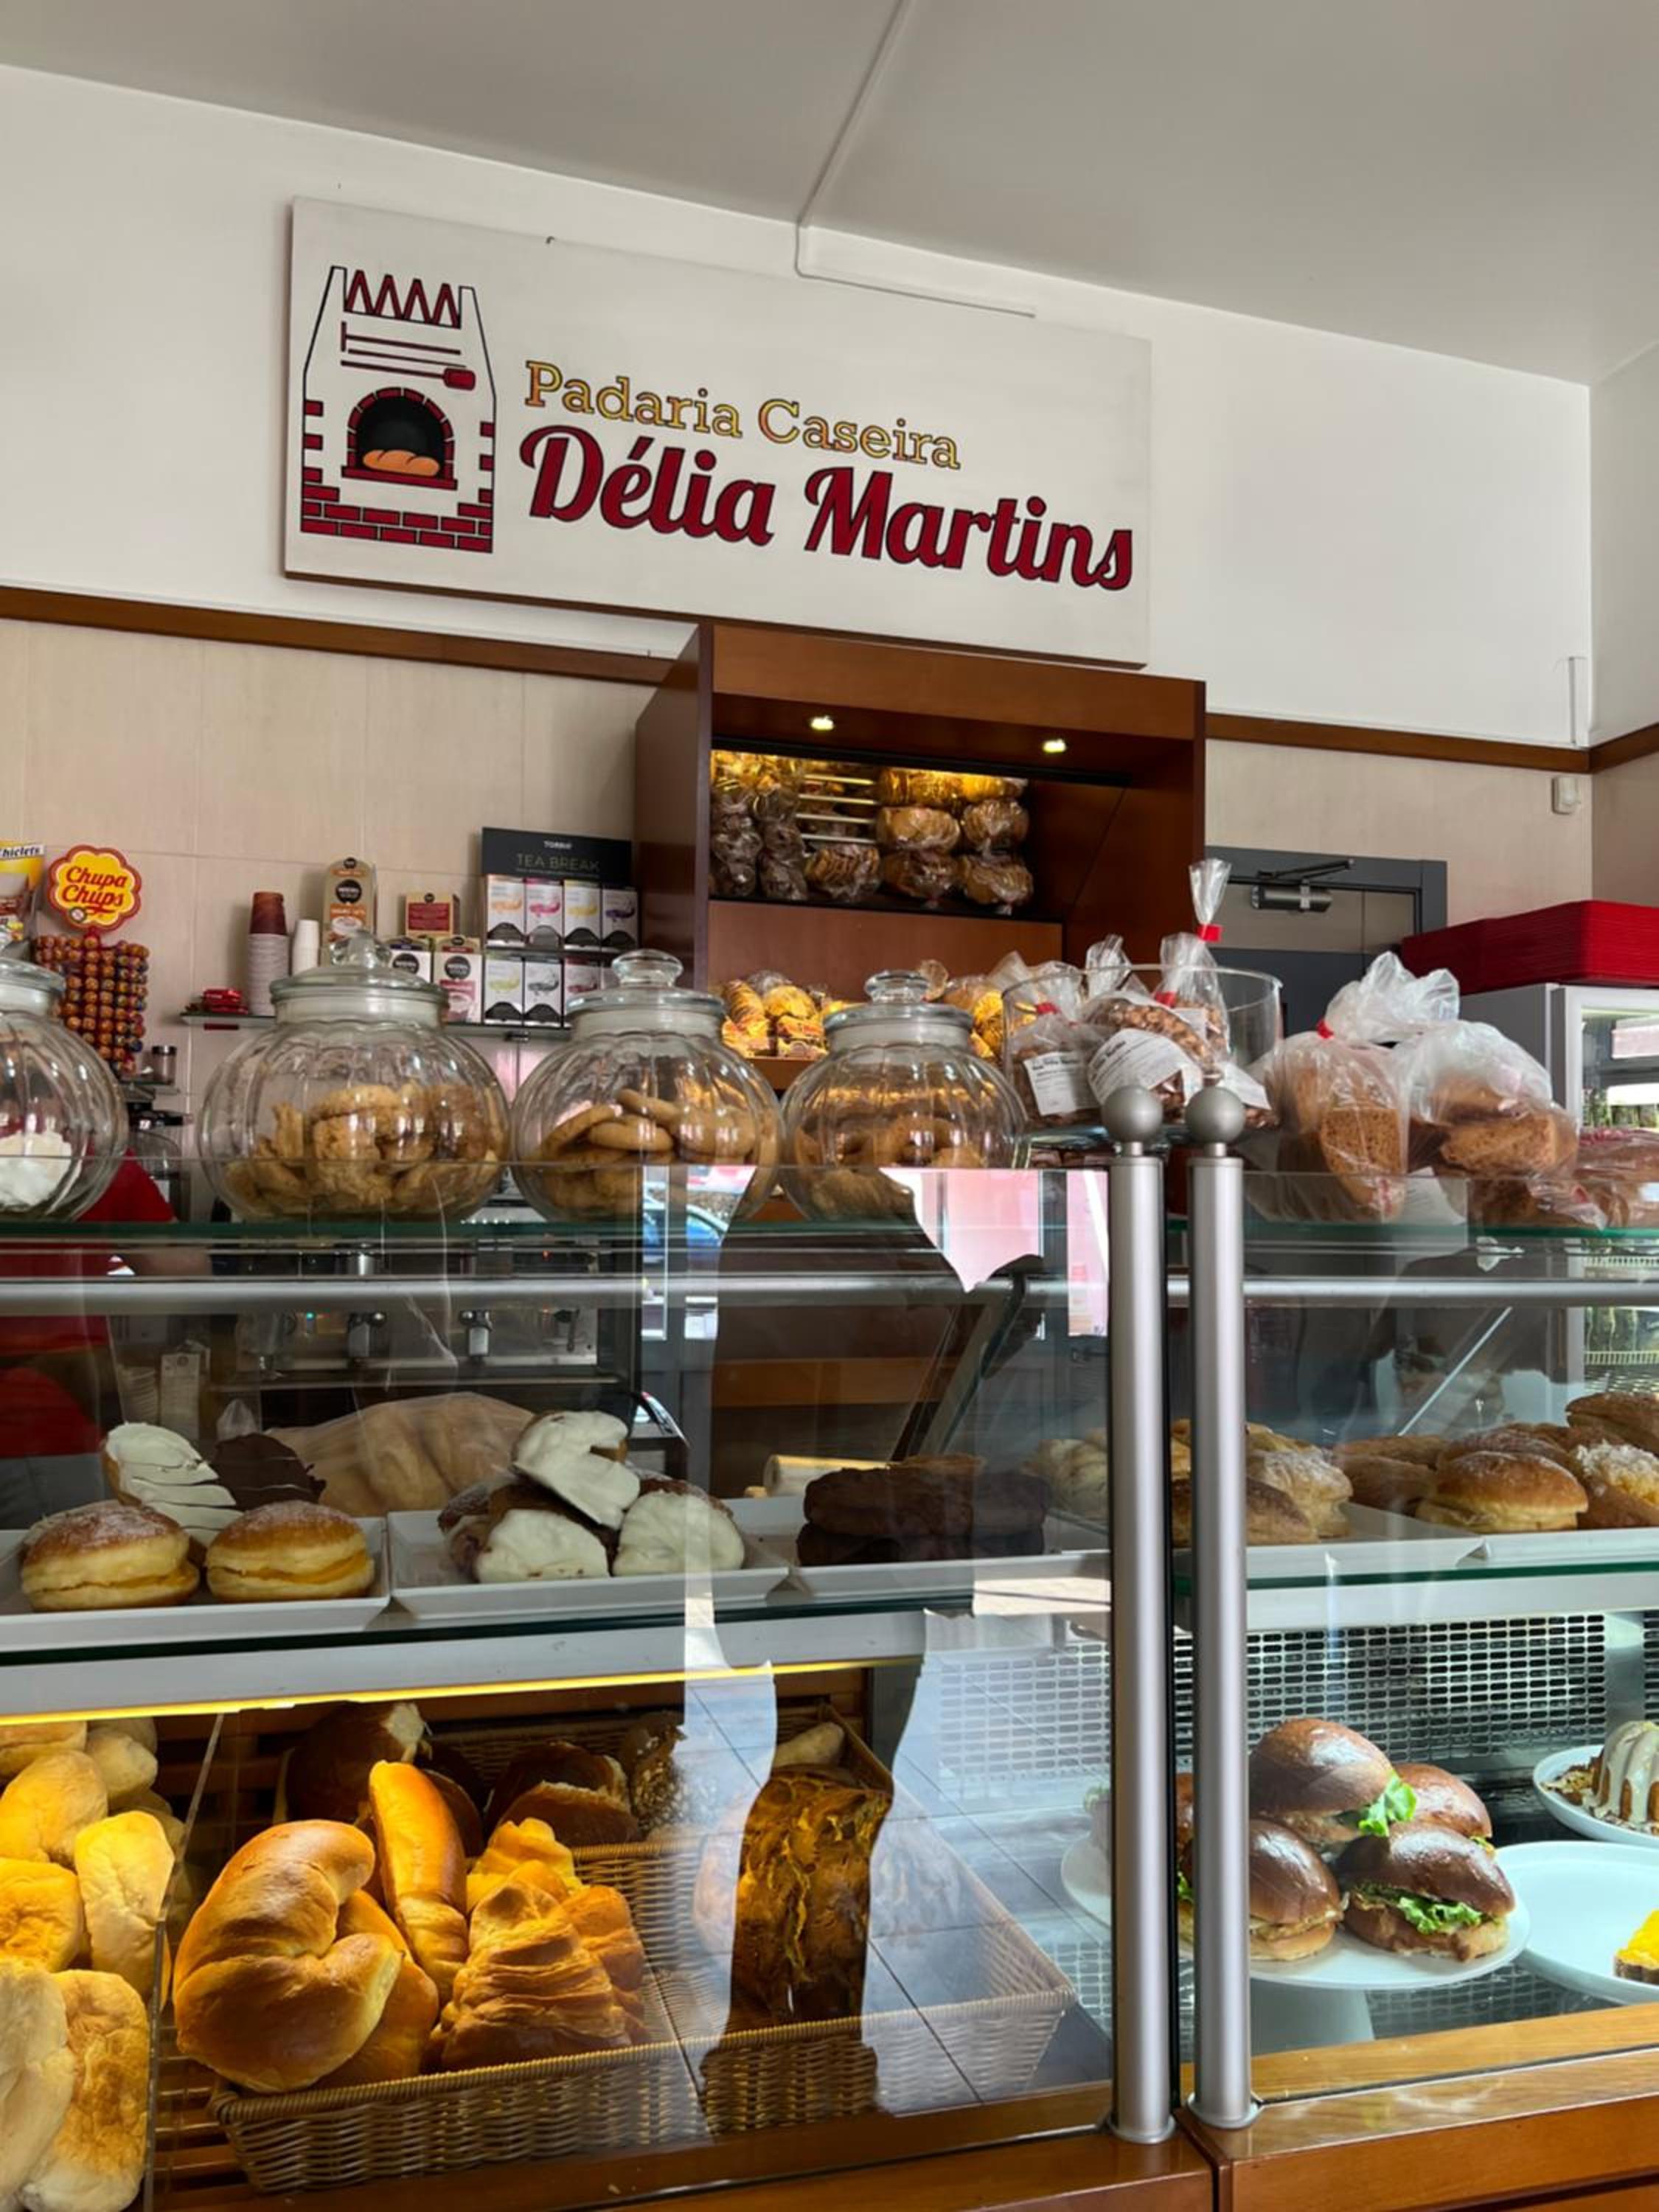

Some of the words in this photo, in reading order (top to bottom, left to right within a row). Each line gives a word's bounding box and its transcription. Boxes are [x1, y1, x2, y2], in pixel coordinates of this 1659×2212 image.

[524, 360, 743, 439] Padaria
[758, 398, 961, 470] Caseira
[519, 425, 776, 547] Délia
[804, 466, 1133, 591] Martins
[0, 846, 40, 858] hiclets
[517, 853, 546, 868] TEA
[550, 857, 599, 872] BREAK
[66, 866, 128, 891] Chupa
[62, 884, 125, 912] Chups
